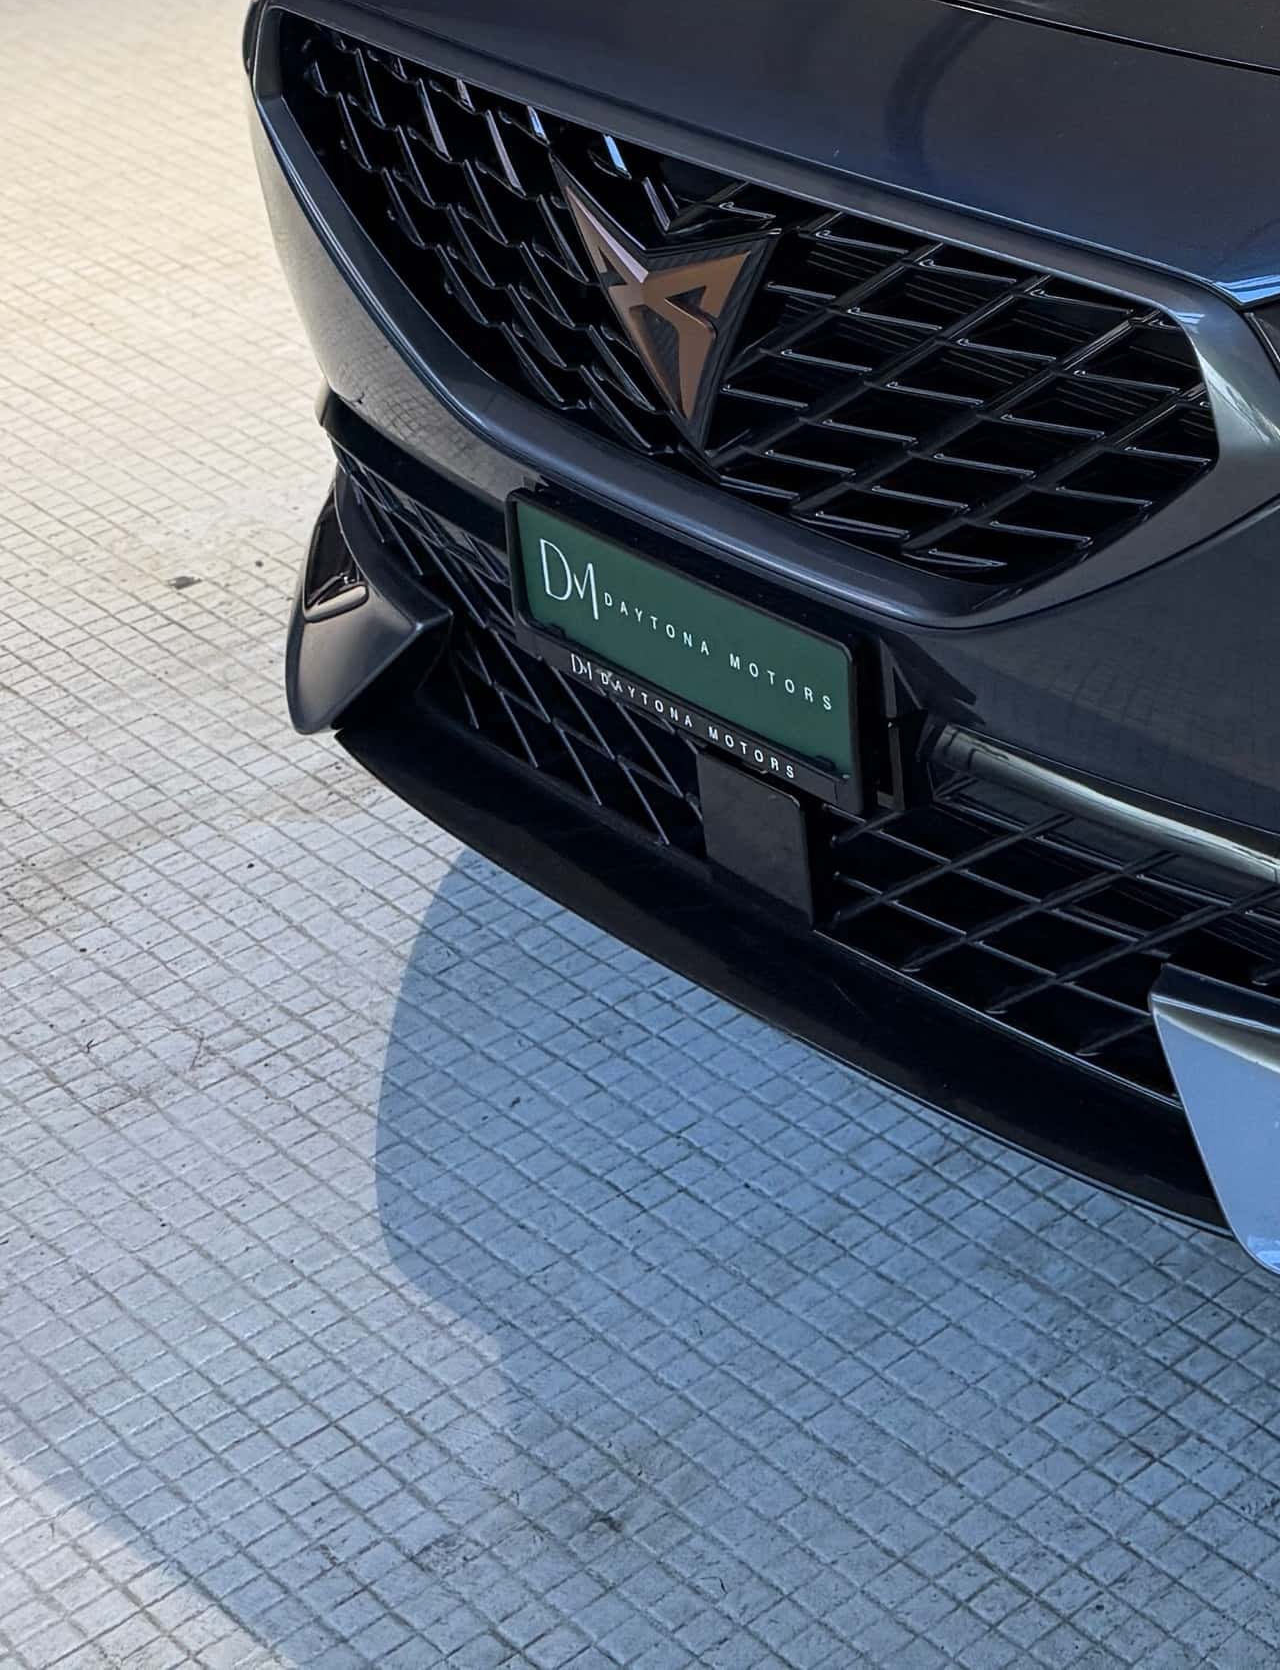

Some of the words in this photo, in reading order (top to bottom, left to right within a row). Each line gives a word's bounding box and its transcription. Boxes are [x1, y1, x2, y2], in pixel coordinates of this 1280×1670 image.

[604, 592, 710, 657] DAYTONA
[729, 652, 833, 711] MOTORS
[600, 671, 693, 728] DAYTONA
[708, 726, 795, 779] MOTORS
